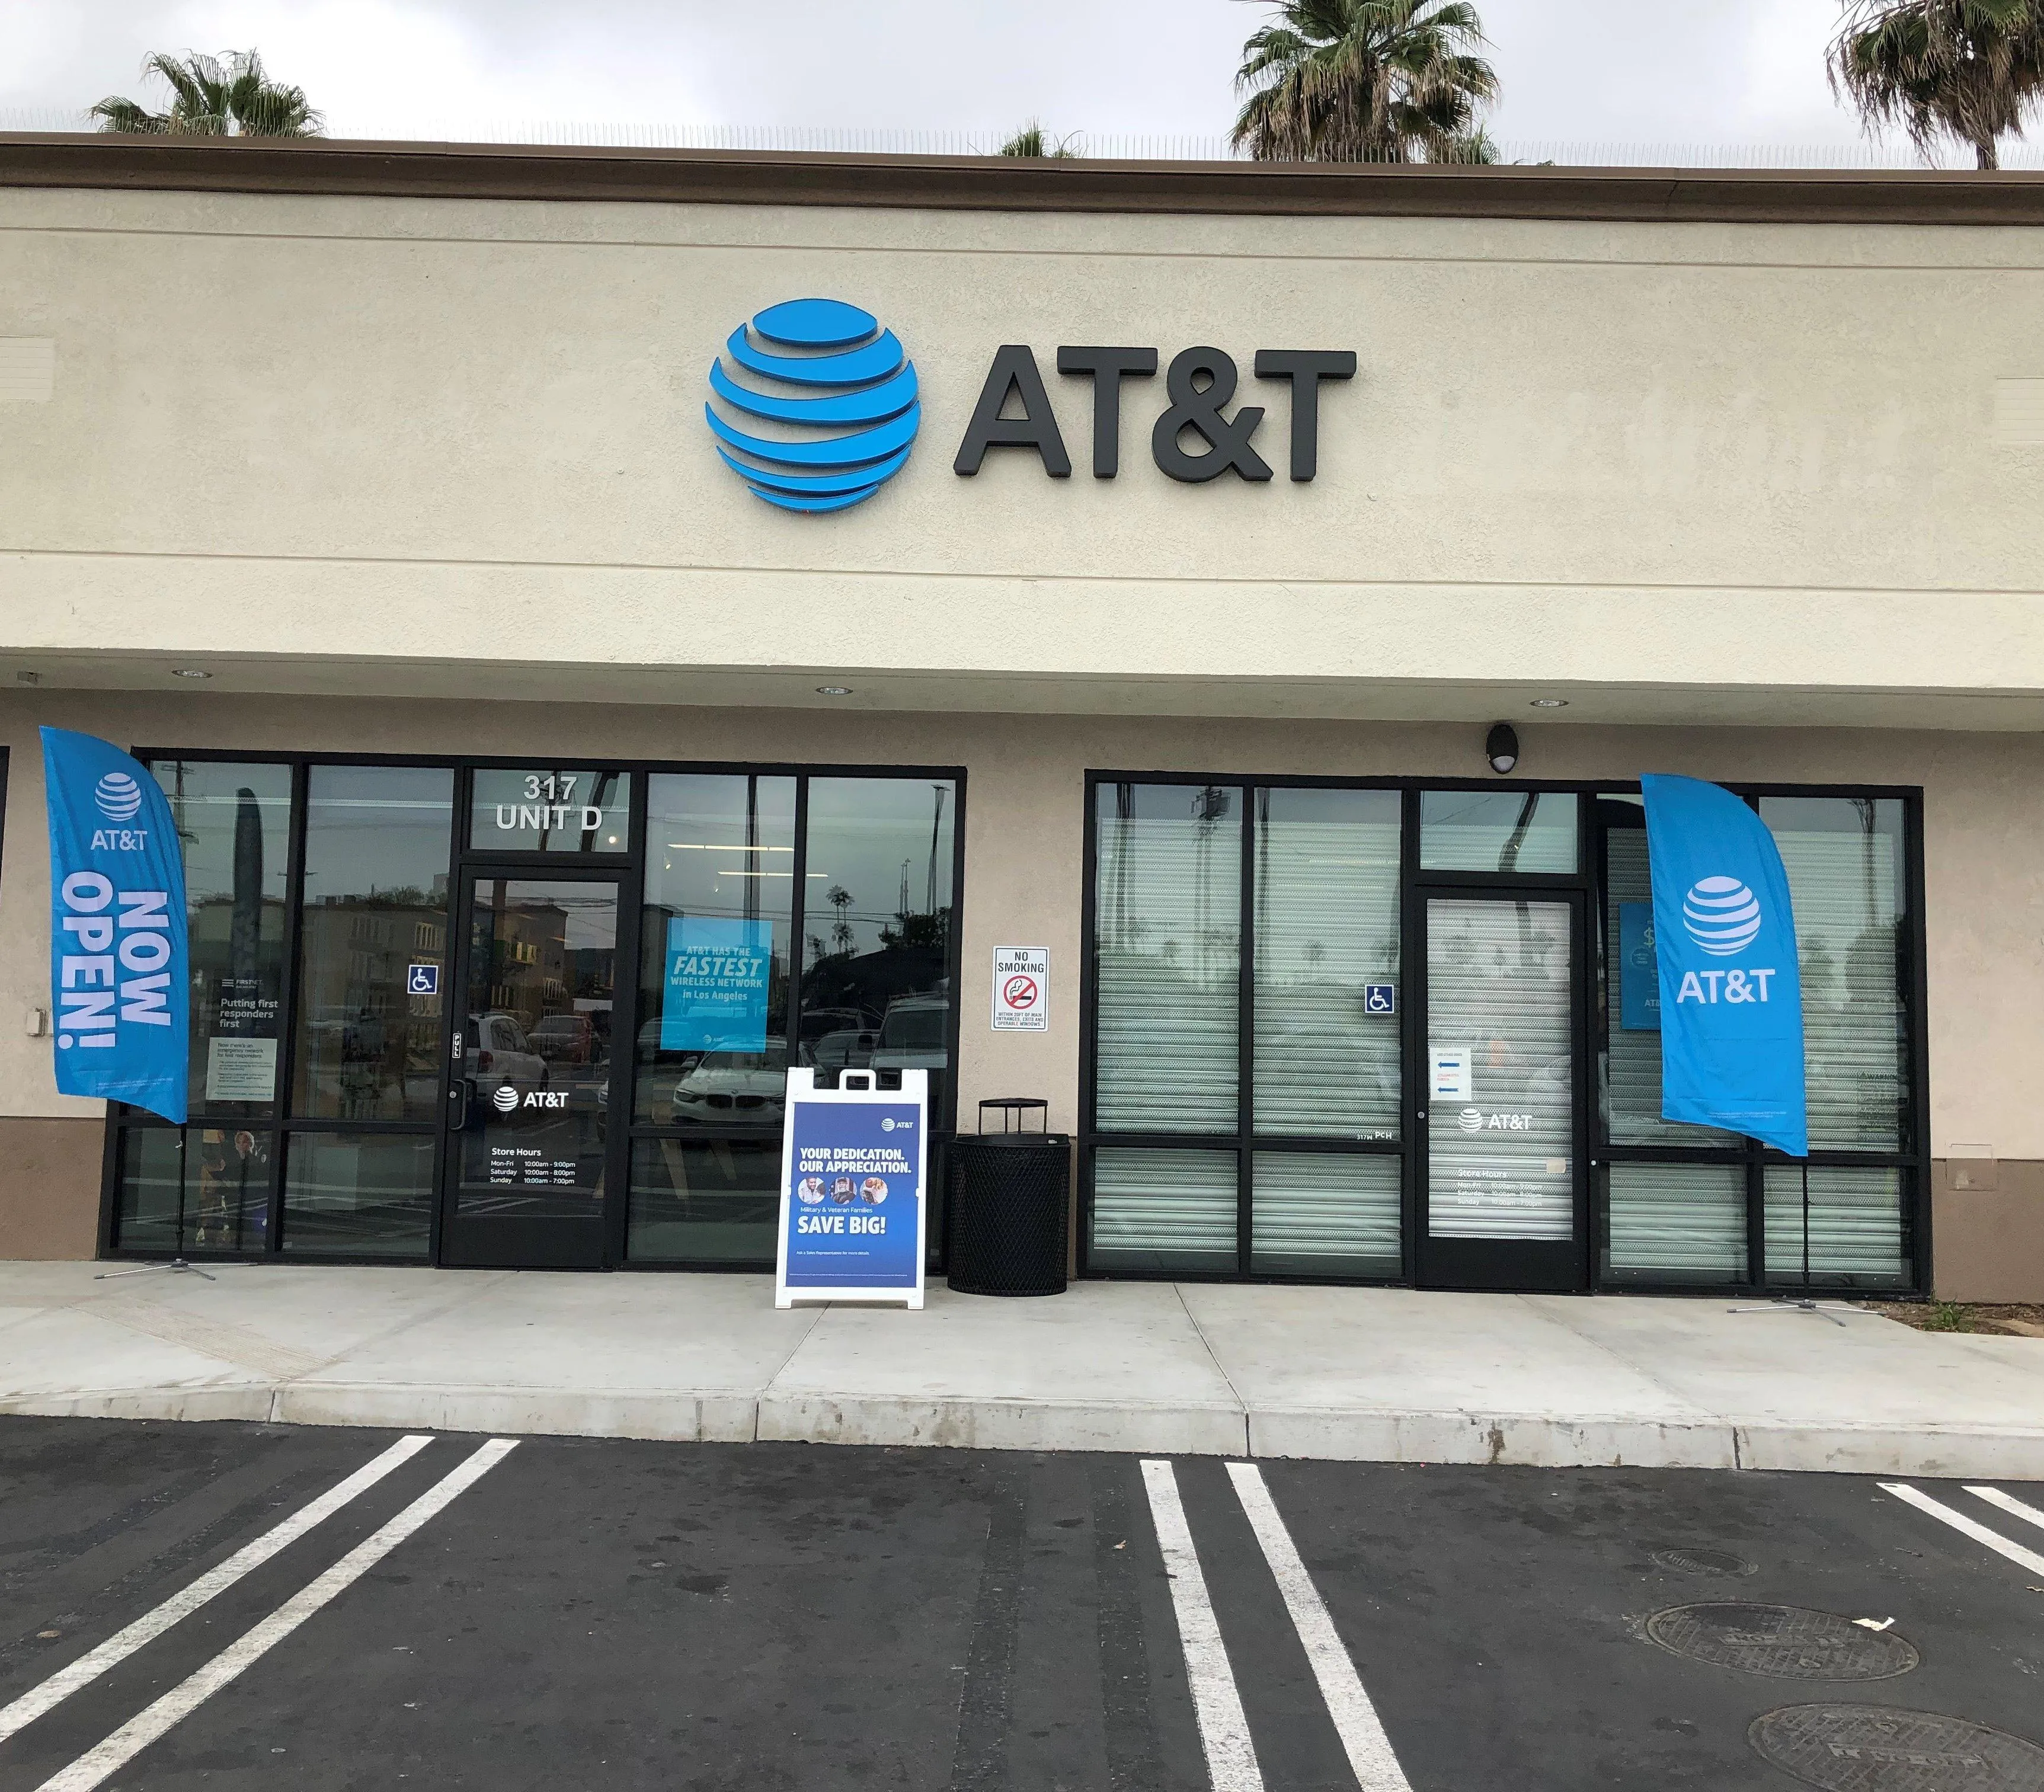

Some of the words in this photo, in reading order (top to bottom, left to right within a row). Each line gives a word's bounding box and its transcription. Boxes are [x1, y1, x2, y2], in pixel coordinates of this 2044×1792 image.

[953, 345, 1357, 483] AT&T
[524, 775, 577, 799] 317
[497, 805, 571, 830] UNIT
[581, 807, 602, 830] D
[91, 830, 148, 850] AT&T
[686, 946, 710, 955] AT&T
[712, 947, 730, 955] HAS
[1015, 952, 1028, 961] NO
[58, 871, 116, 1049] OPEN!
[119, 891, 171, 1026] NOW
[673, 956, 763, 977] FASTEST
[998, 962, 1044, 972] SMOKING
[671, 977, 715, 986] WIRELESS
[718, 978, 763, 988] NETWORK
[1677, 969, 1776, 1004] AT&T
[683, 990, 691, 999] in
[694, 990, 709, 1000] Los
[712, 990, 747, 1002] Angeles
[221, 998, 255, 1009] Putting
[258, 999, 278, 1008] first
[1645, 999, 1660, 1007] AT&
[220, 1010, 274, 1019] responders
[219, 1019, 239, 1028] first
[523, 1092, 569, 1108] AT&T
[1488, 1114, 1533, 1130] AT&T
[491, 1148, 514, 1156] Store
[516, 1148, 542, 1156] Hours
[800, 1148, 831, 1160] YOUR
[833, 1148, 905, 1160] DEDICATION.
[799, 1160, 824, 1172] OUR
[826, 1161, 912, 1173] APPRECIATION.
[1458, 1169, 1480, 1177] Store
[1482, 1170, 1507, 1179] Hours
[797, 1215, 845, 1234] SAVE
[849, 1217, 886, 1234] BIG!
